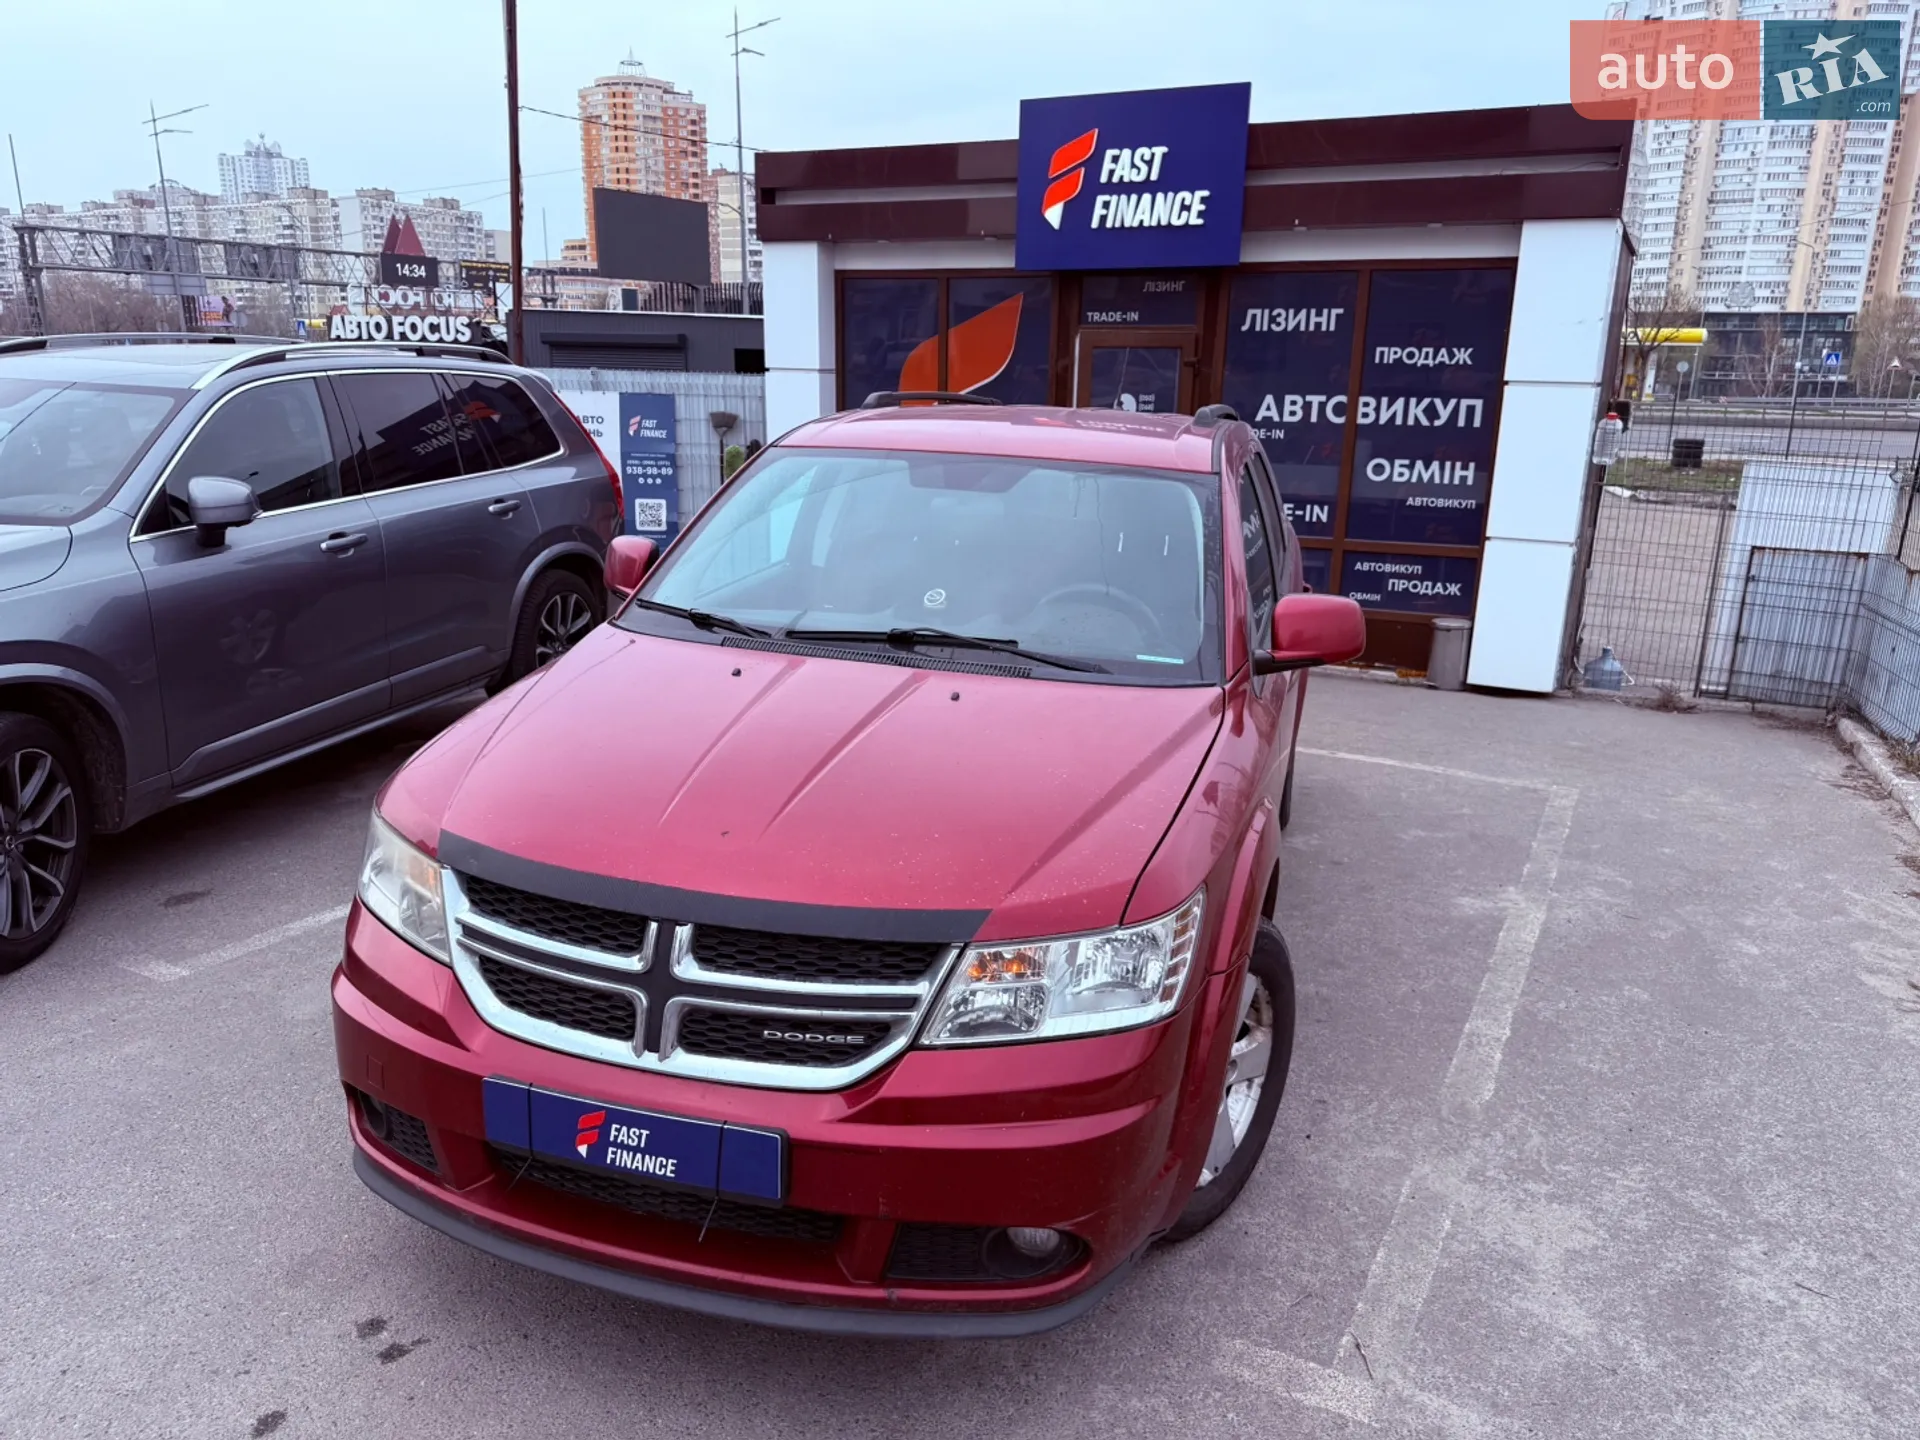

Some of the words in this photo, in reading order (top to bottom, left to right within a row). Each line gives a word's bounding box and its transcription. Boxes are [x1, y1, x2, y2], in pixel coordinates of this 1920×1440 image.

[1099, 145, 1170, 184] FAST
[1090, 190, 1211, 230] FINANCE
[396, 262, 427, 279] 14:34
[1143, 281, 1186, 292] ЛІЗИНГ
[1086, 311, 1139, 322] TRADE-IN
[1240, 308, 1344, 332] ЛІЗИНГ
[330, 314, 388, 341] АВТО
[391, 314, 473, 343] FOCUS
[1374, 347, 1474, 367] ПРОДАЖ
[641, 419, 657, 428] FAST
[640, 429, 668, 439] FINANCE
[1366, 458, 1476, 486] ОБМІН
[1405, 497, 1476, 510] АВТОВИКУП
[1354, 562, 1422, 575] АВТОВИКУП
[1387, 579, 1462, 596] ПРОДАЖ
[763, 1030, 865, 1044] DODGE
[609, 1124, 650, 1148] FAST
[606, 1147, 677, 1177] FINANCE
